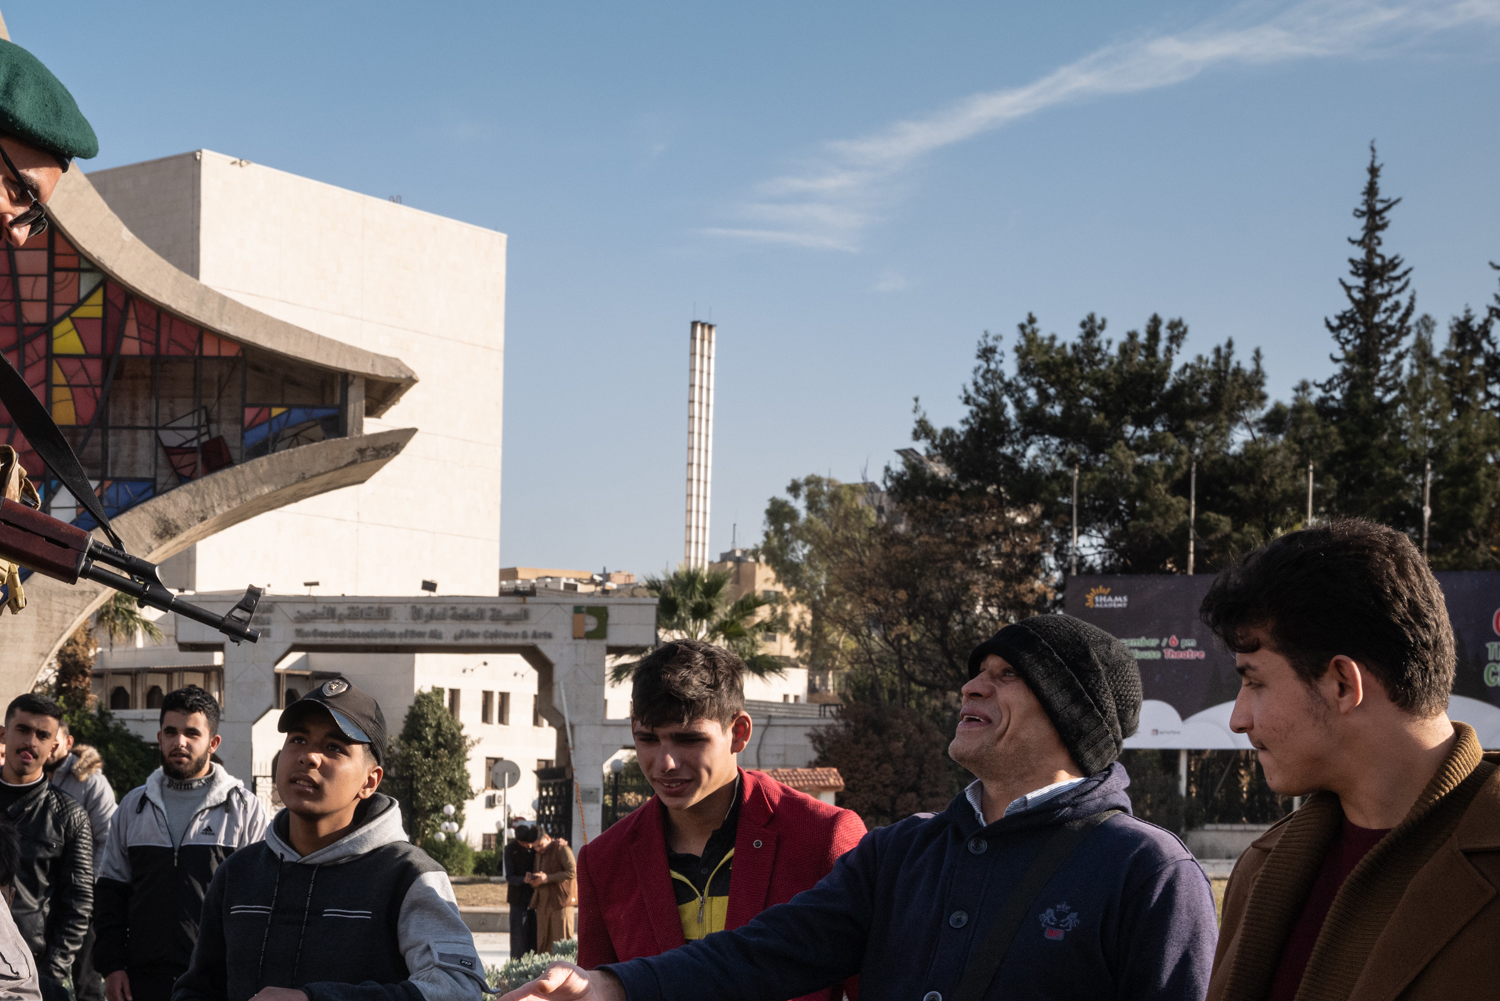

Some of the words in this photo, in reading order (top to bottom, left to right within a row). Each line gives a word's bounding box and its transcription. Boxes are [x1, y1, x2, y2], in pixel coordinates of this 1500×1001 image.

[1094, 595, 1128, 603] SHAMS
[1168, 634, 1179, 647] 6
[1180, 638, 1197, 649] pm
[1162, 648, 1206, 659] Theatre
[167, 777, 193, 789] Palm
